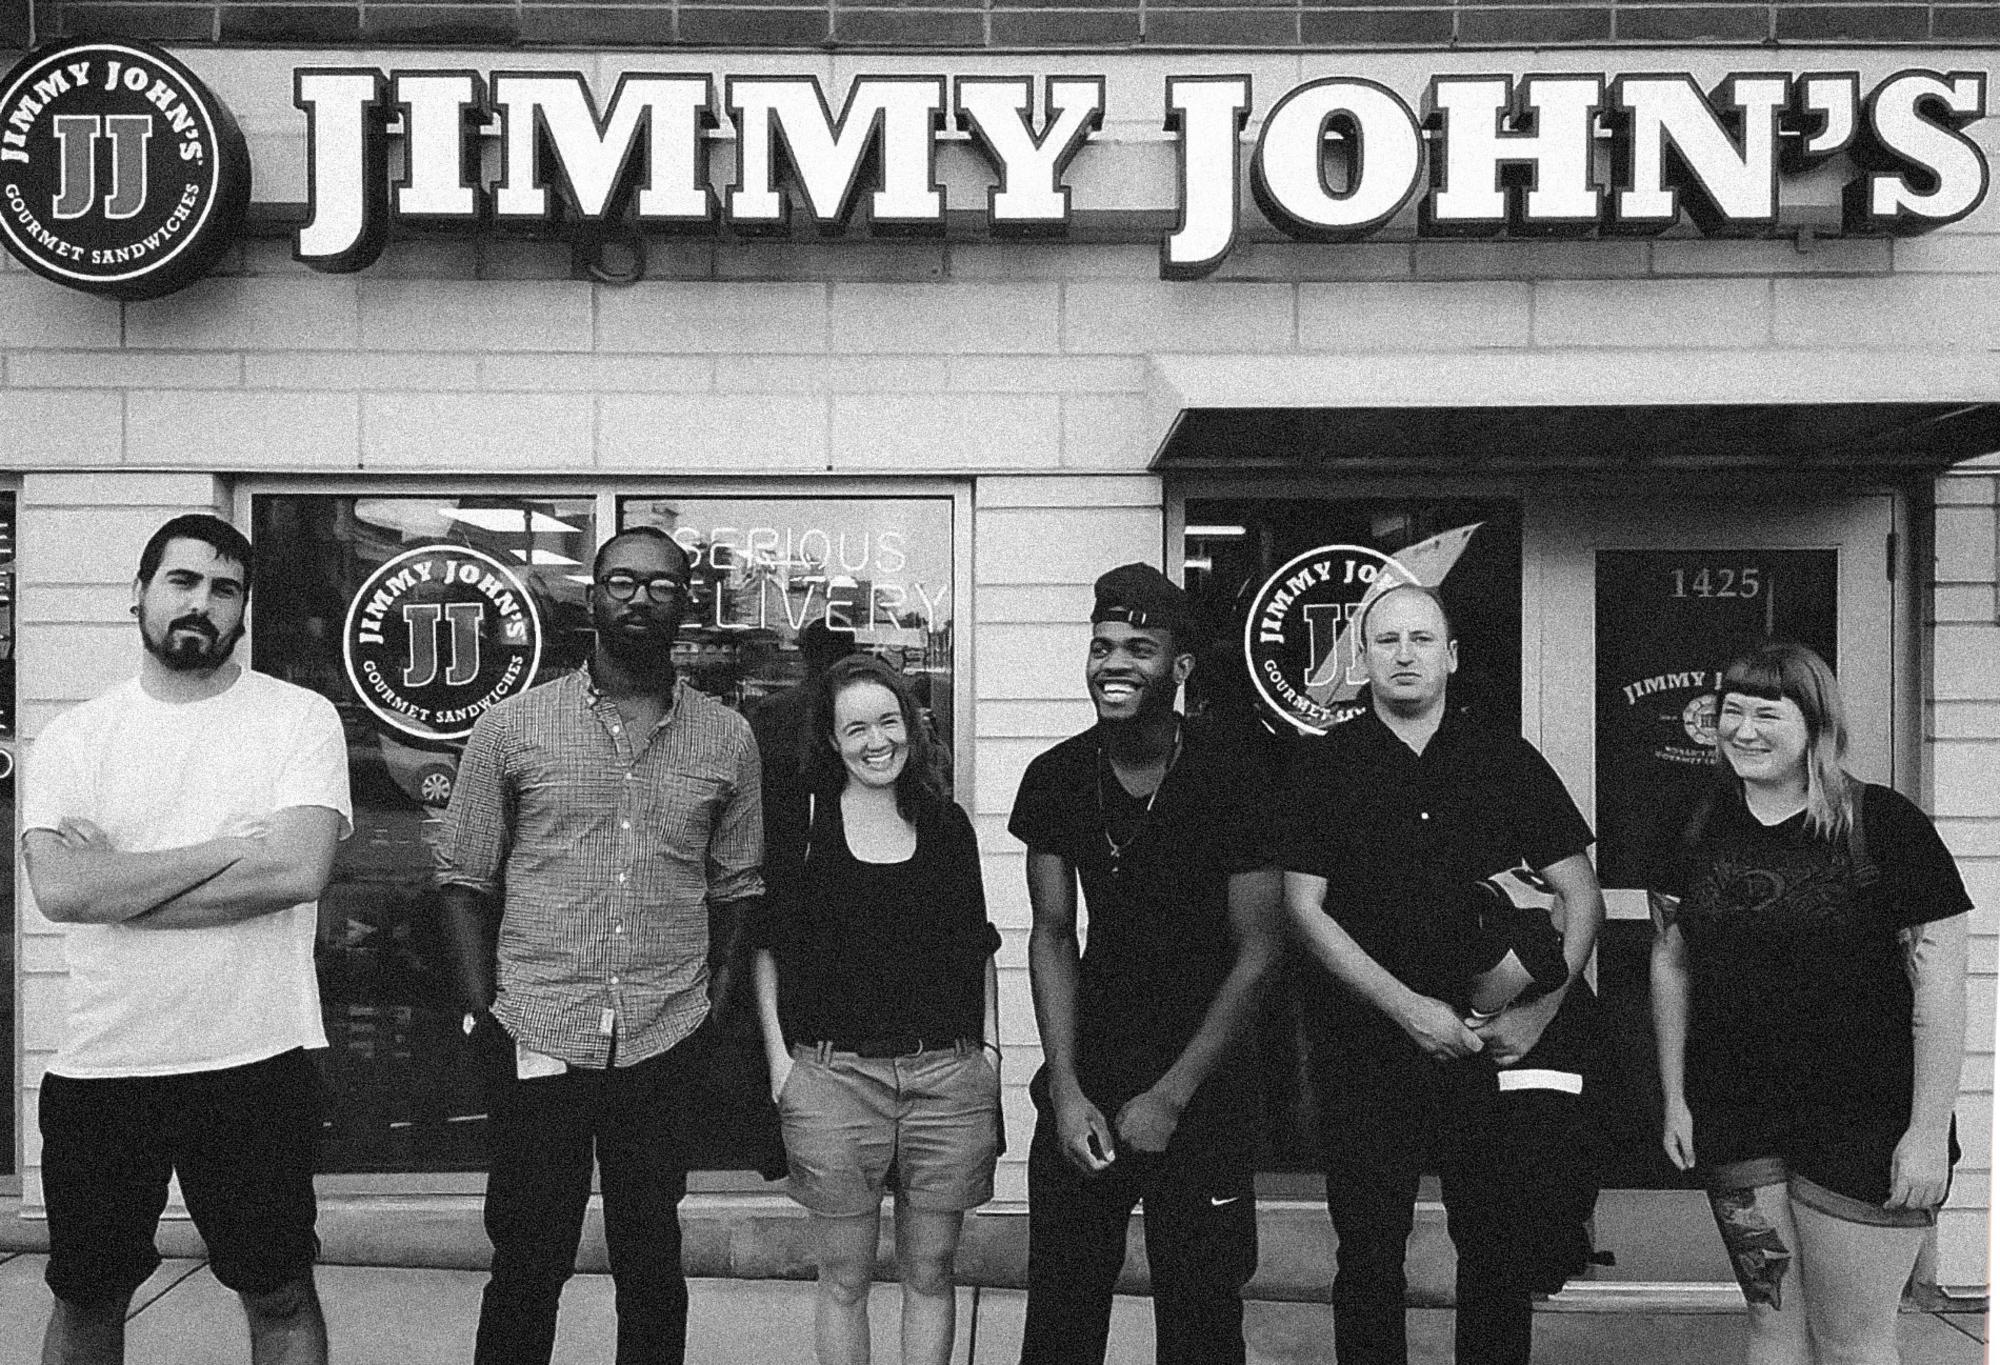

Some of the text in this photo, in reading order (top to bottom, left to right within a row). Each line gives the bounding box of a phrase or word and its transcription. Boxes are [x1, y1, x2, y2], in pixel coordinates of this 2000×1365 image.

[1, 61, 202, 163] JIMMY JOHN'S
[53, 115, 152, 219] JJ
[297, 69, 1989, 268] JIMMY JOHN'S
[5, 183, 199, 264] GOURMET SANDWICHES
[672, 527, 905, 572] SERIOUS
[1671, 568, 1759, 598] 1425
[359, 560, 527, 644] JIMMY JOHN'S
[1260, 560, 1331, 644] JIMMY
[403, 603, 484, 687] JJ
[363, 655, 523, 723] GOURMET SANDWICHES
[1264, 659, 1331, 721] GOURMET
[1622, 671, 1705, 705] JIMMY
